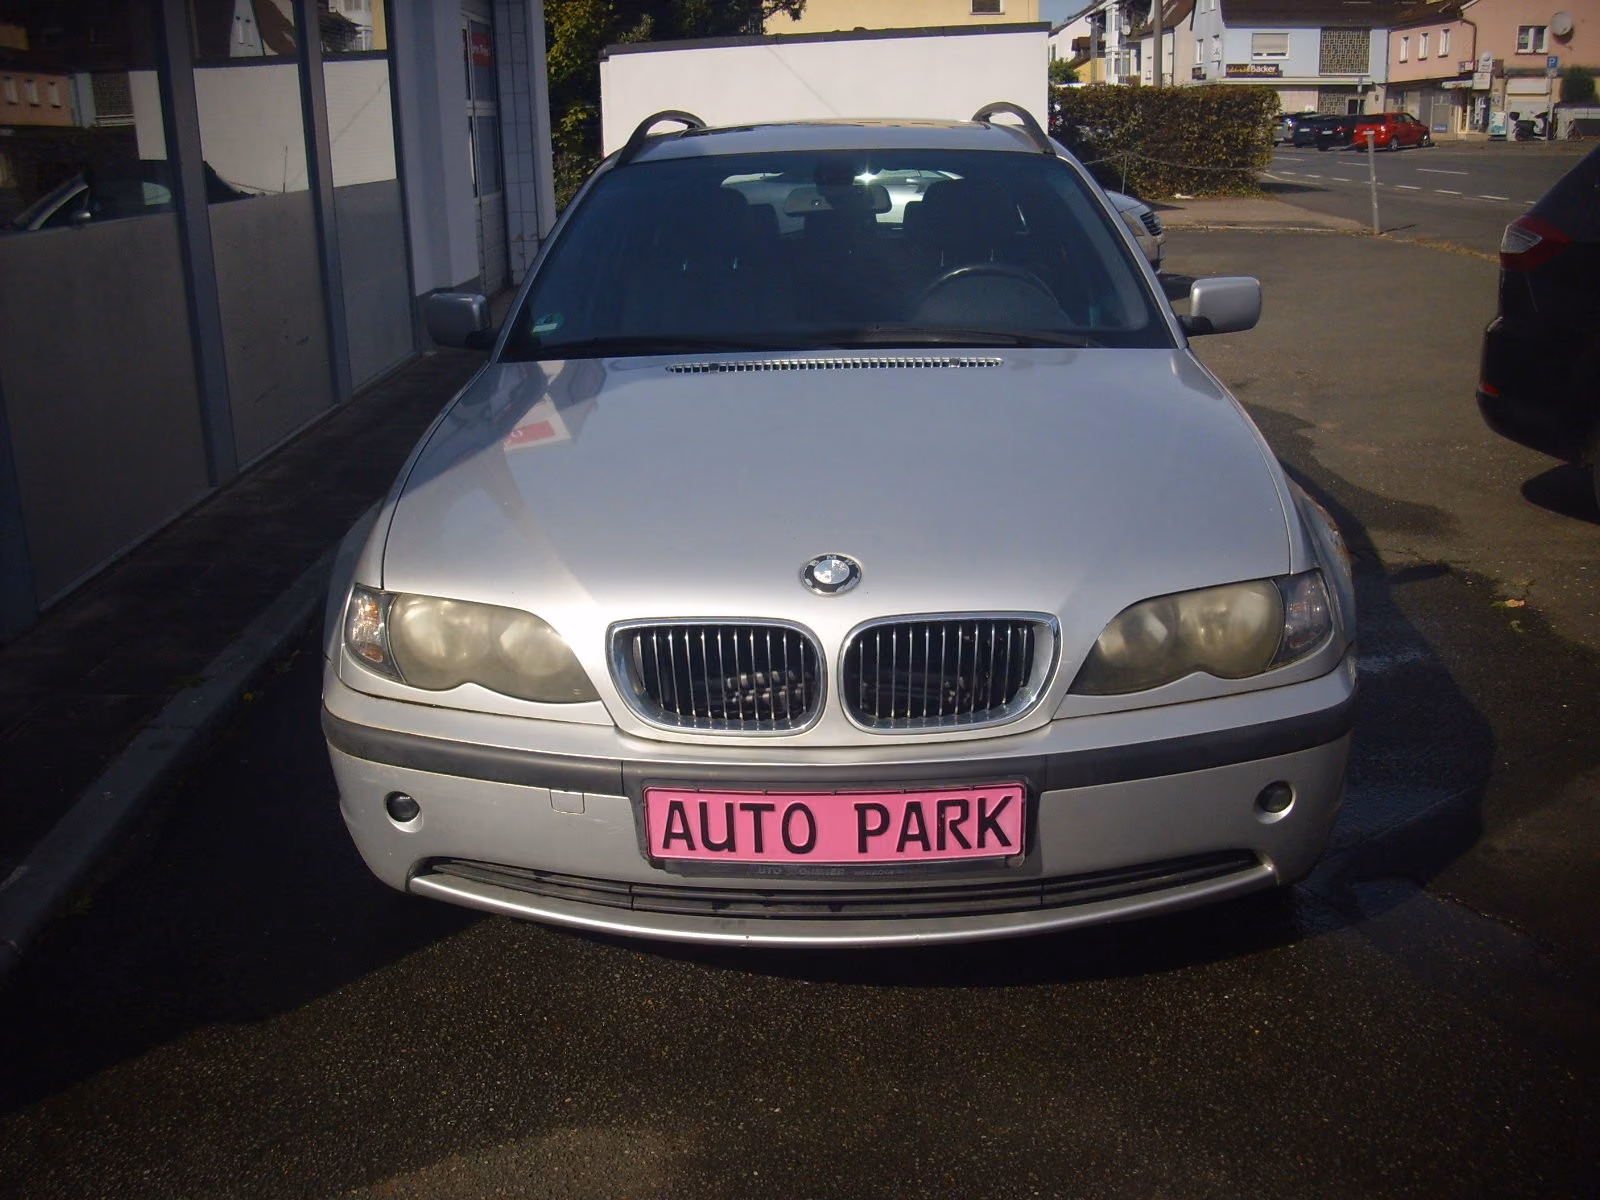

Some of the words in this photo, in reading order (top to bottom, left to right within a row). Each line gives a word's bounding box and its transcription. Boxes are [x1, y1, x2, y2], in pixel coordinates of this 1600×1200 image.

[809, 555, 855, 567] BMW
[661, 799, 818, 855] AUTO
[854, 795, 1014, 853] PARK
